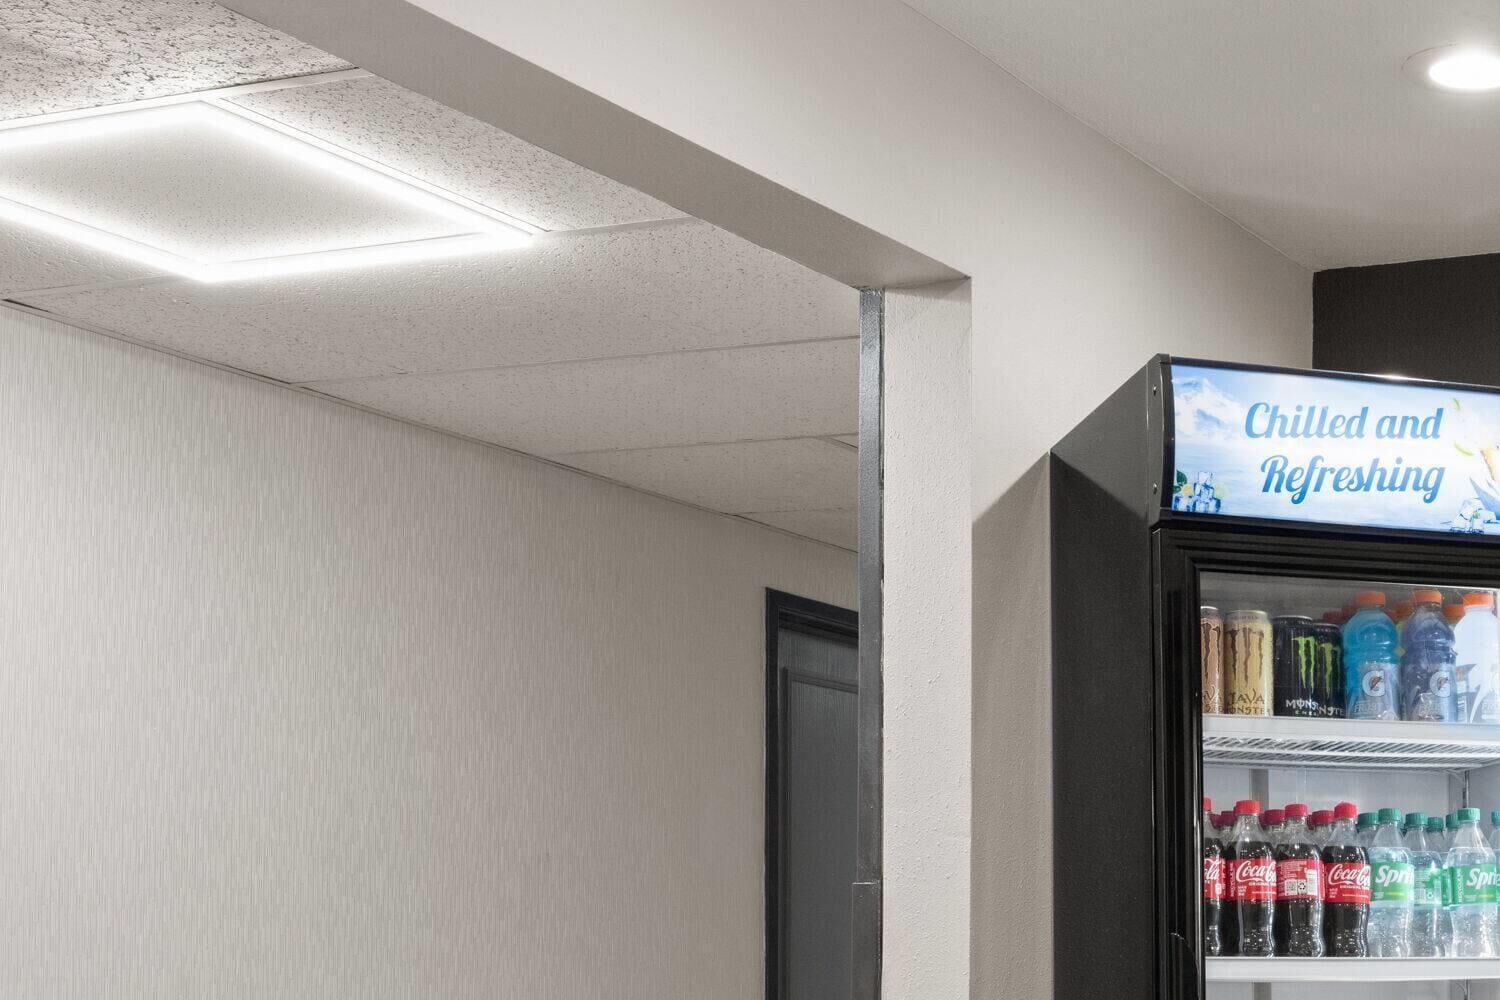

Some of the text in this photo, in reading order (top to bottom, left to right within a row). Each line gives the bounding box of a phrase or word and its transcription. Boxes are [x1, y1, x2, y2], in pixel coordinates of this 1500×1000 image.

[1245, 402, 1444, 440] Chilled and
[1260, 454, 1445, 505] Refreshing
